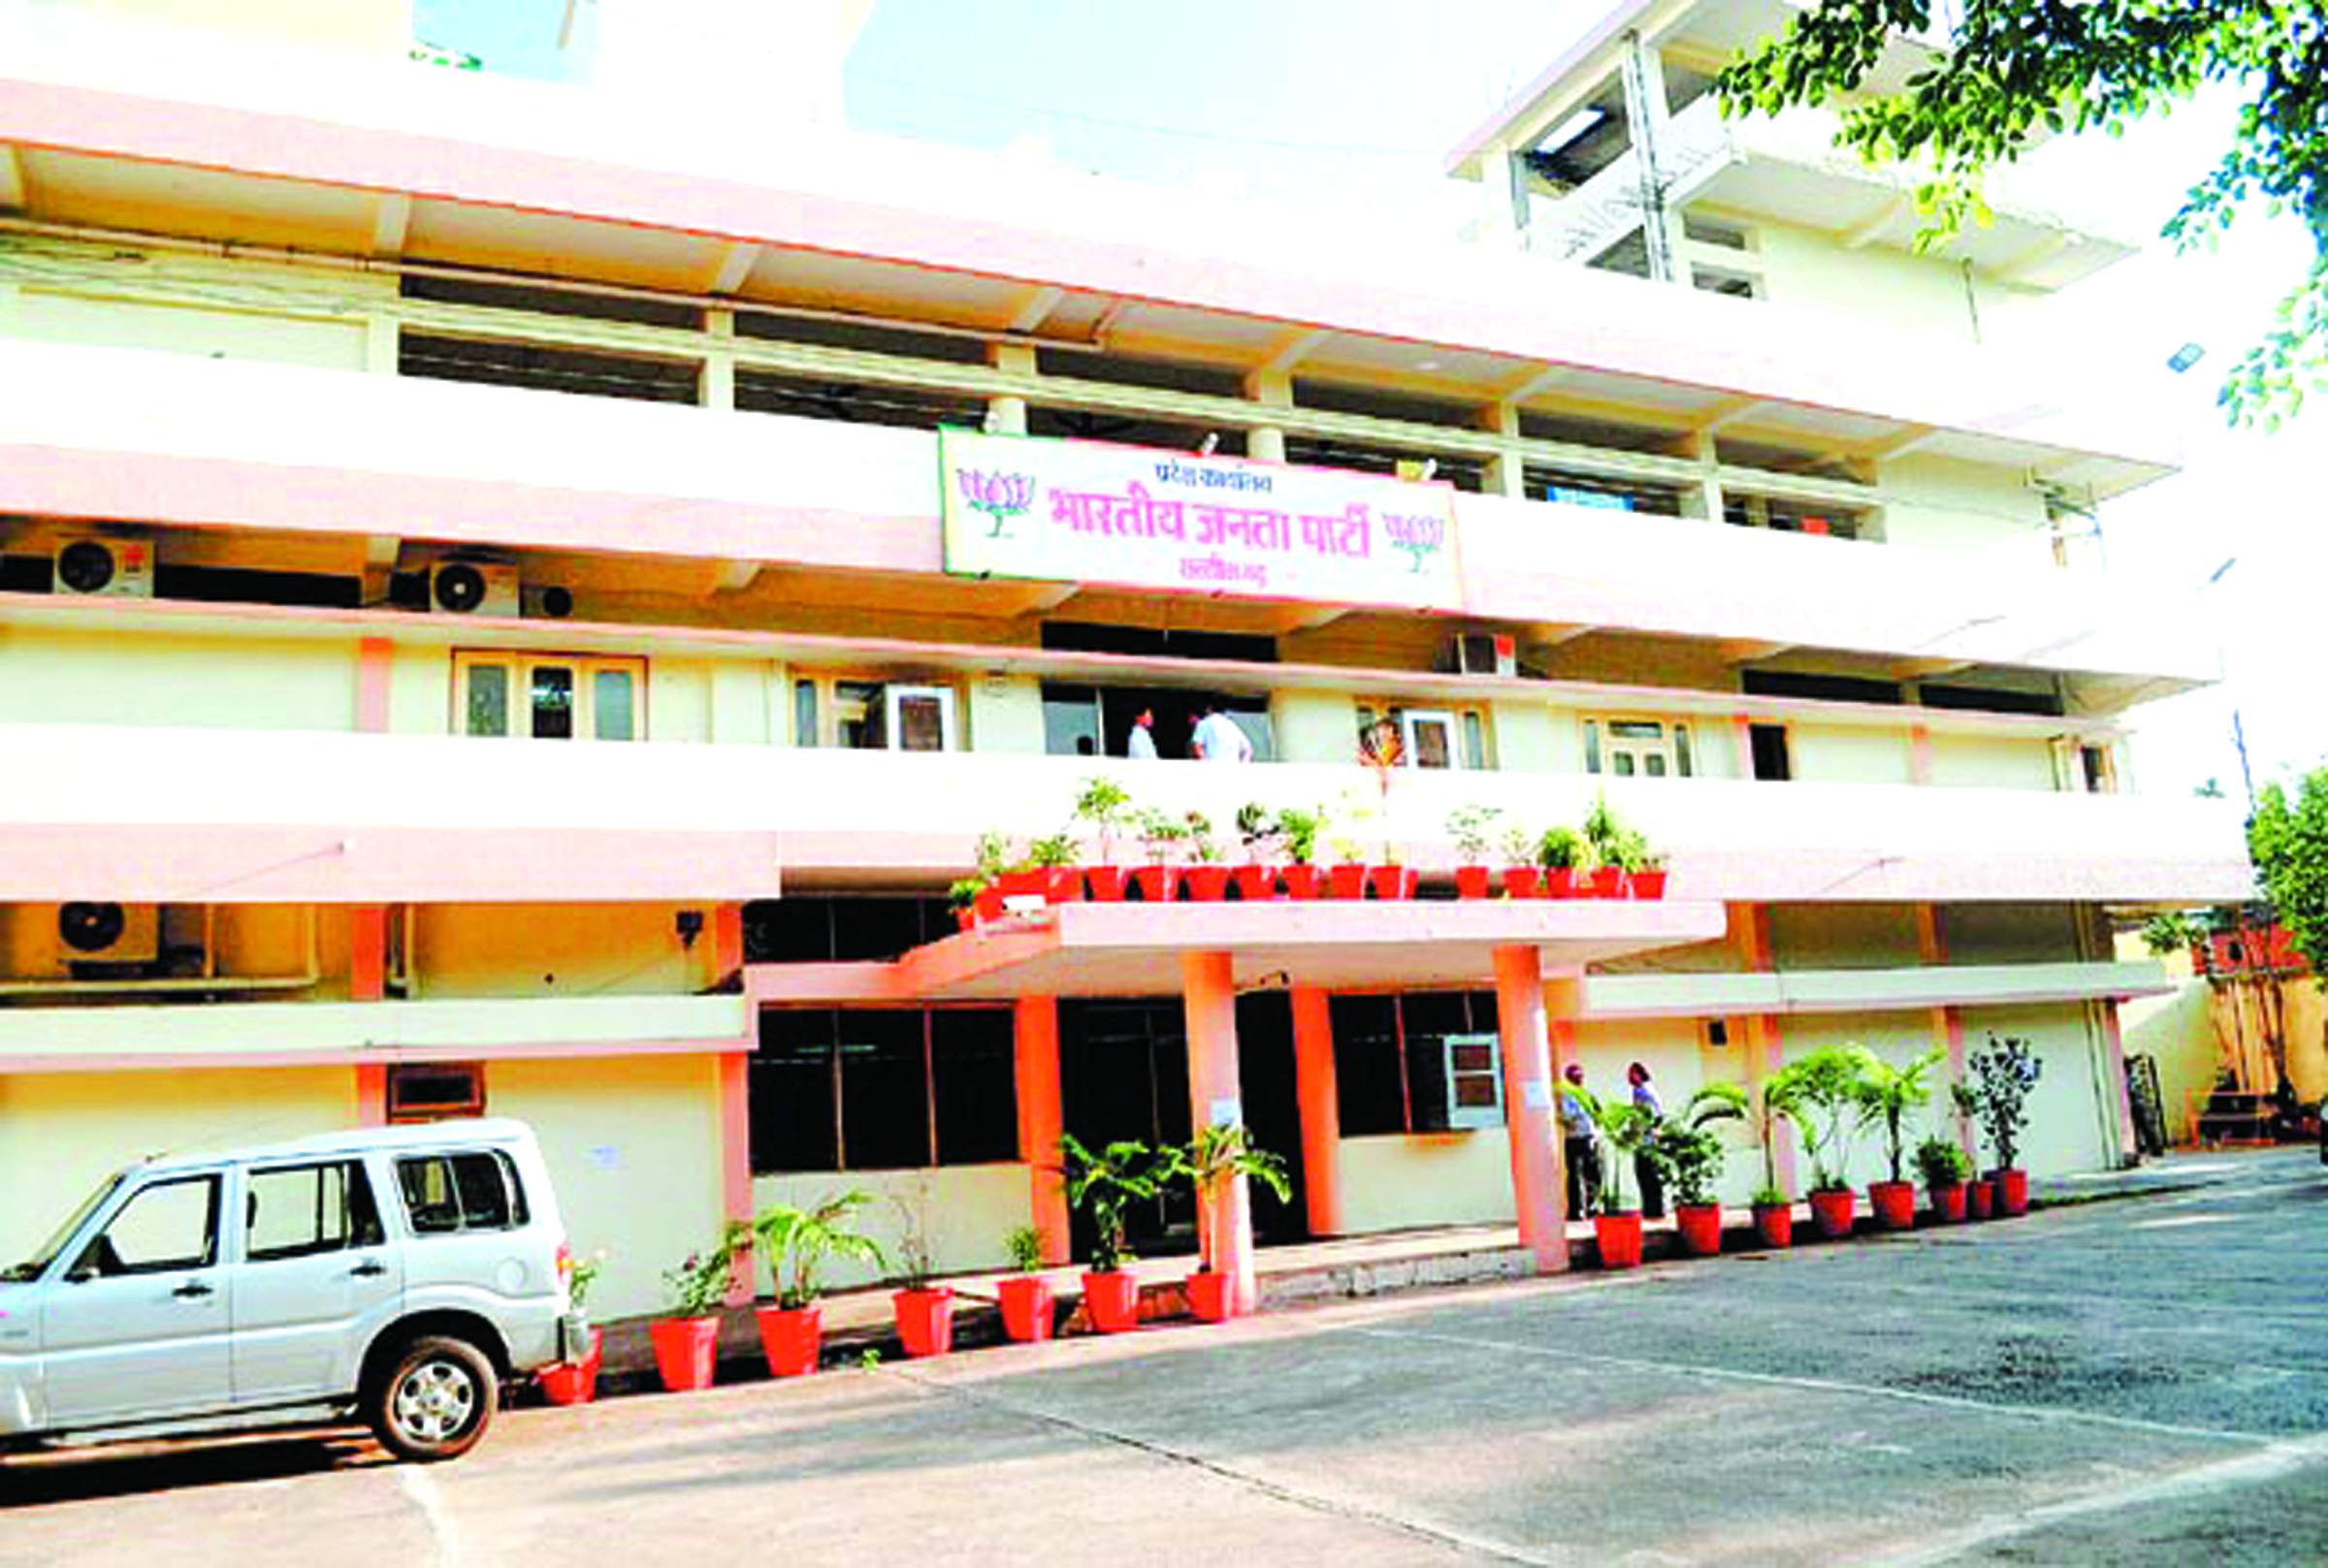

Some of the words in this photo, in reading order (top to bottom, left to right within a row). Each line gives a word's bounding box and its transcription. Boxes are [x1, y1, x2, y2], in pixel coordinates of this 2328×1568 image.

[1049, 479, 1185, 540] भारतीय
[1191, 502, 1290, 552] जनता
[1298, 501, 1371, 559] पार्टी
